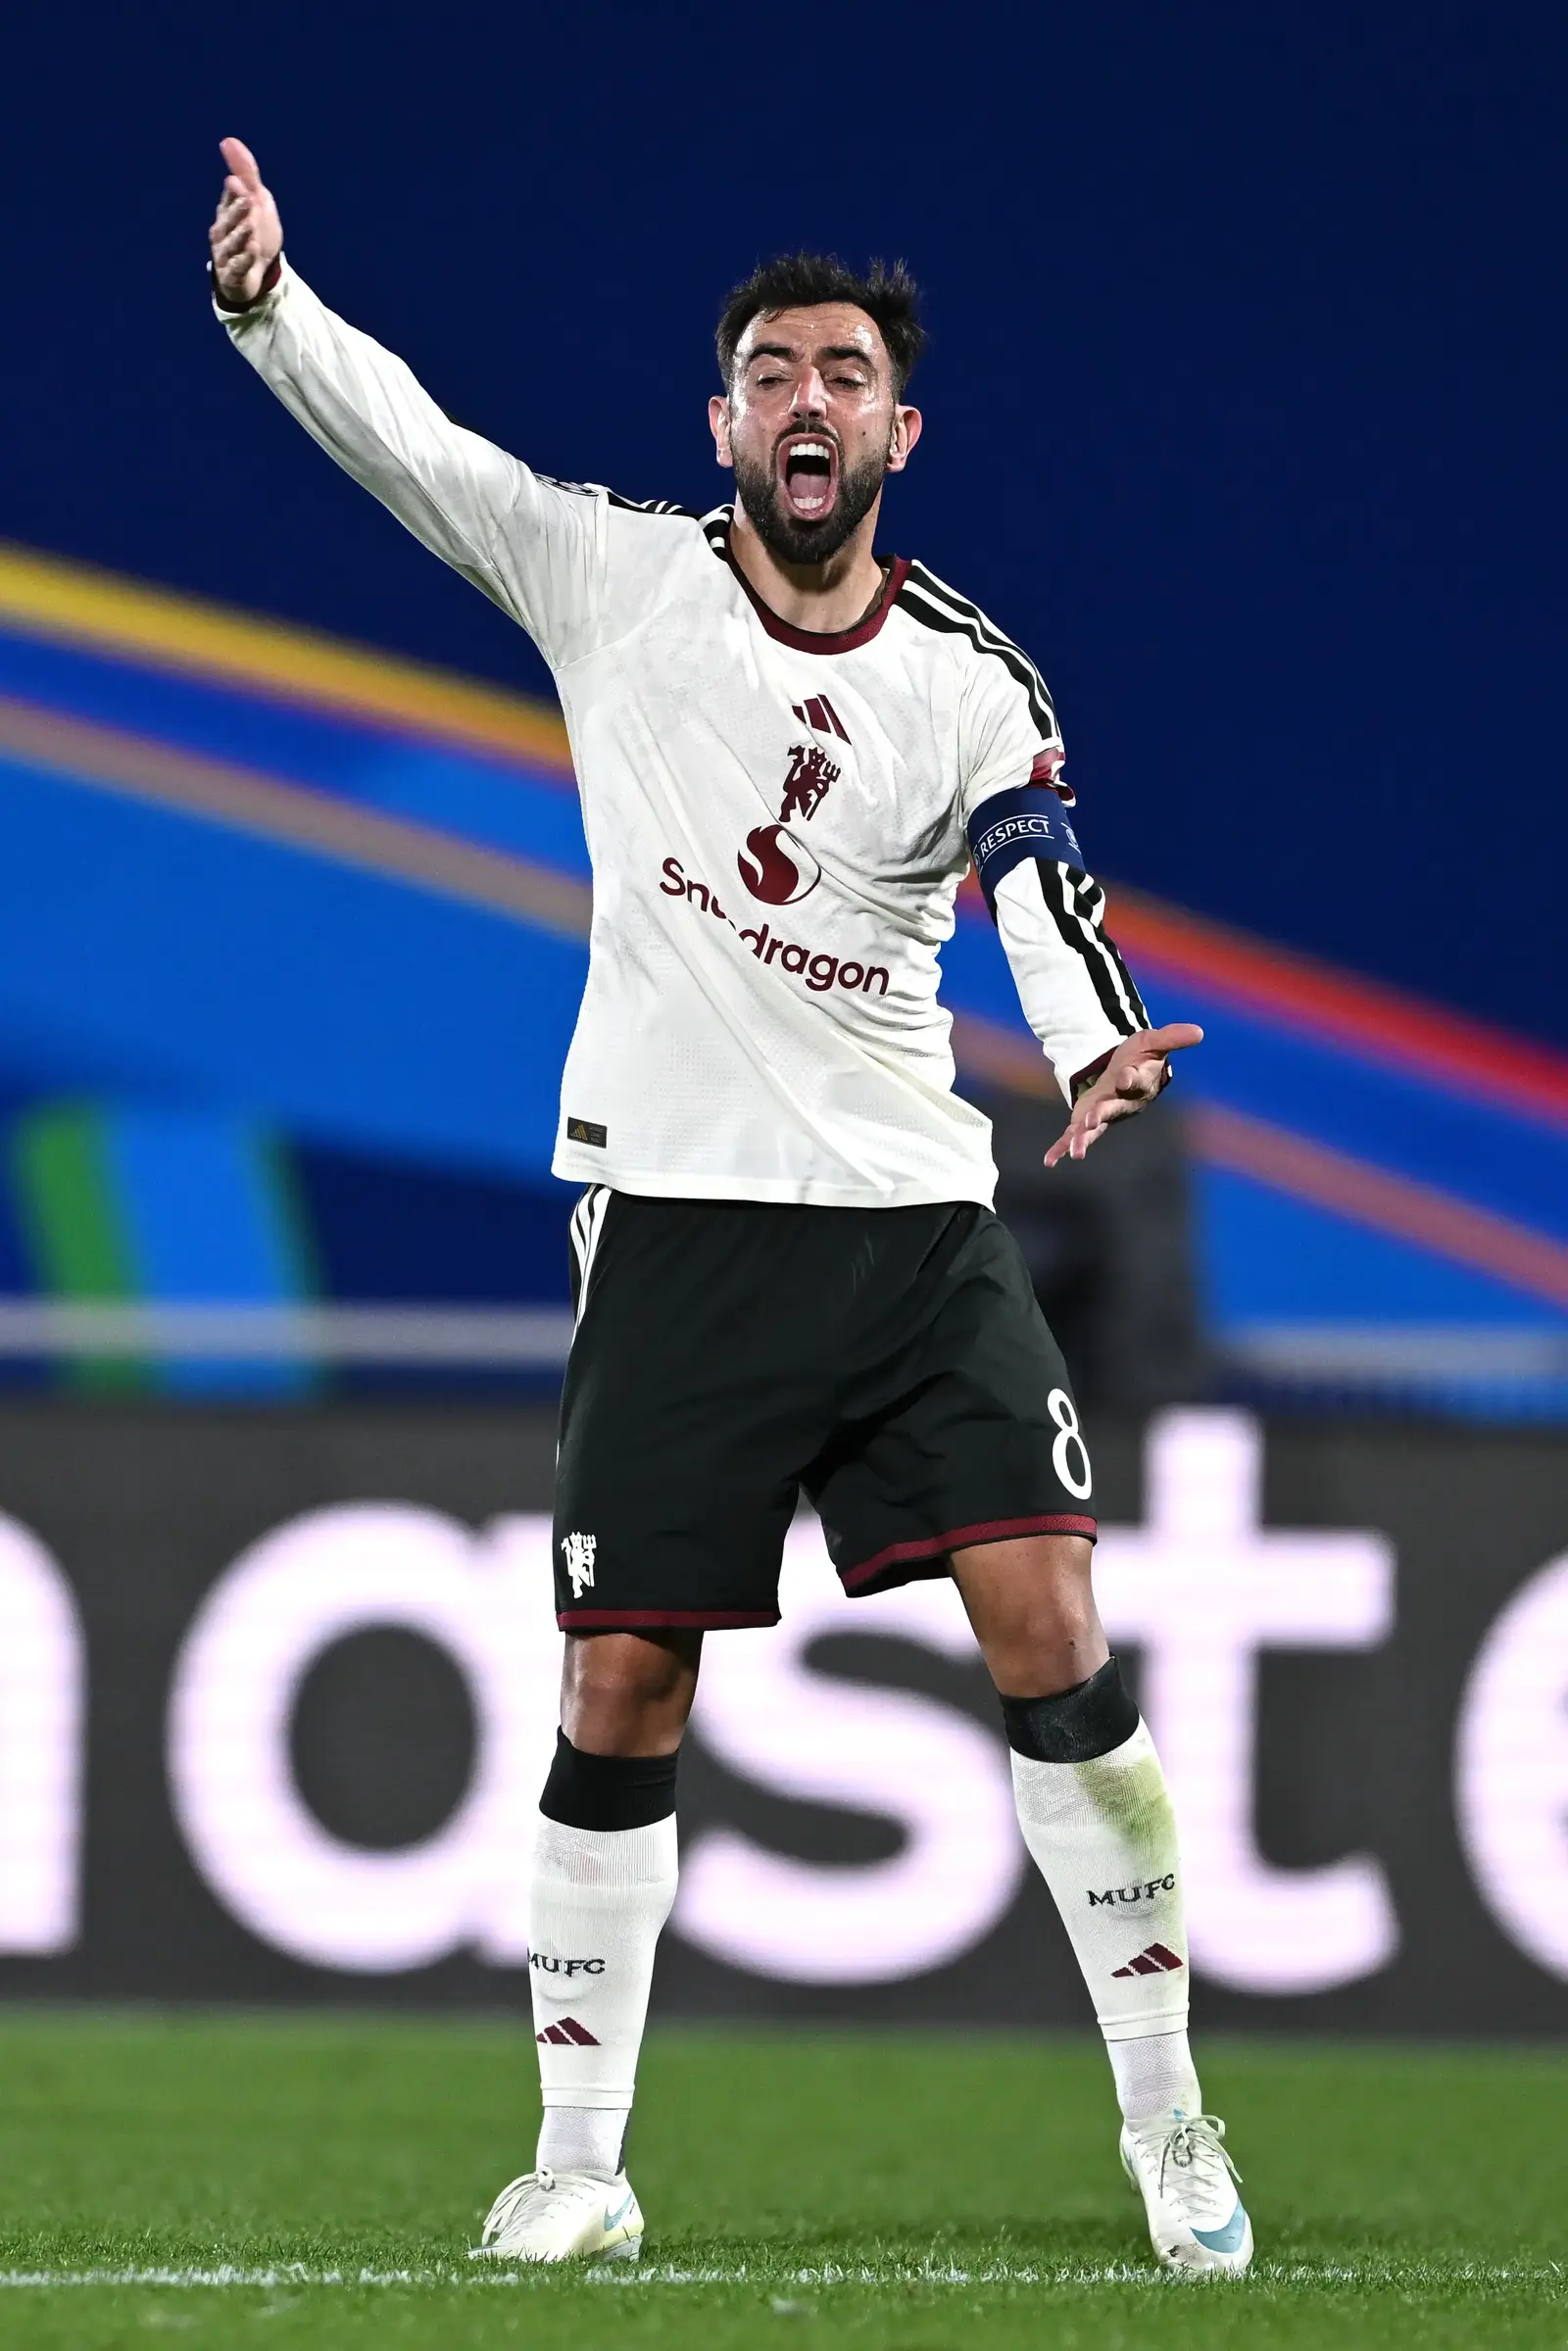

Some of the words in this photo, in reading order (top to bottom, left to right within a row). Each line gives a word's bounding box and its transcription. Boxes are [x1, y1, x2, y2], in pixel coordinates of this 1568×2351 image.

[980, 819, 1050, 857] RESPECT
[660, 857, 890, 996] Sndragon
[1048, 1389, 1093, 1500] 8
[1086, 1873, 1175, 1906] MUFC
